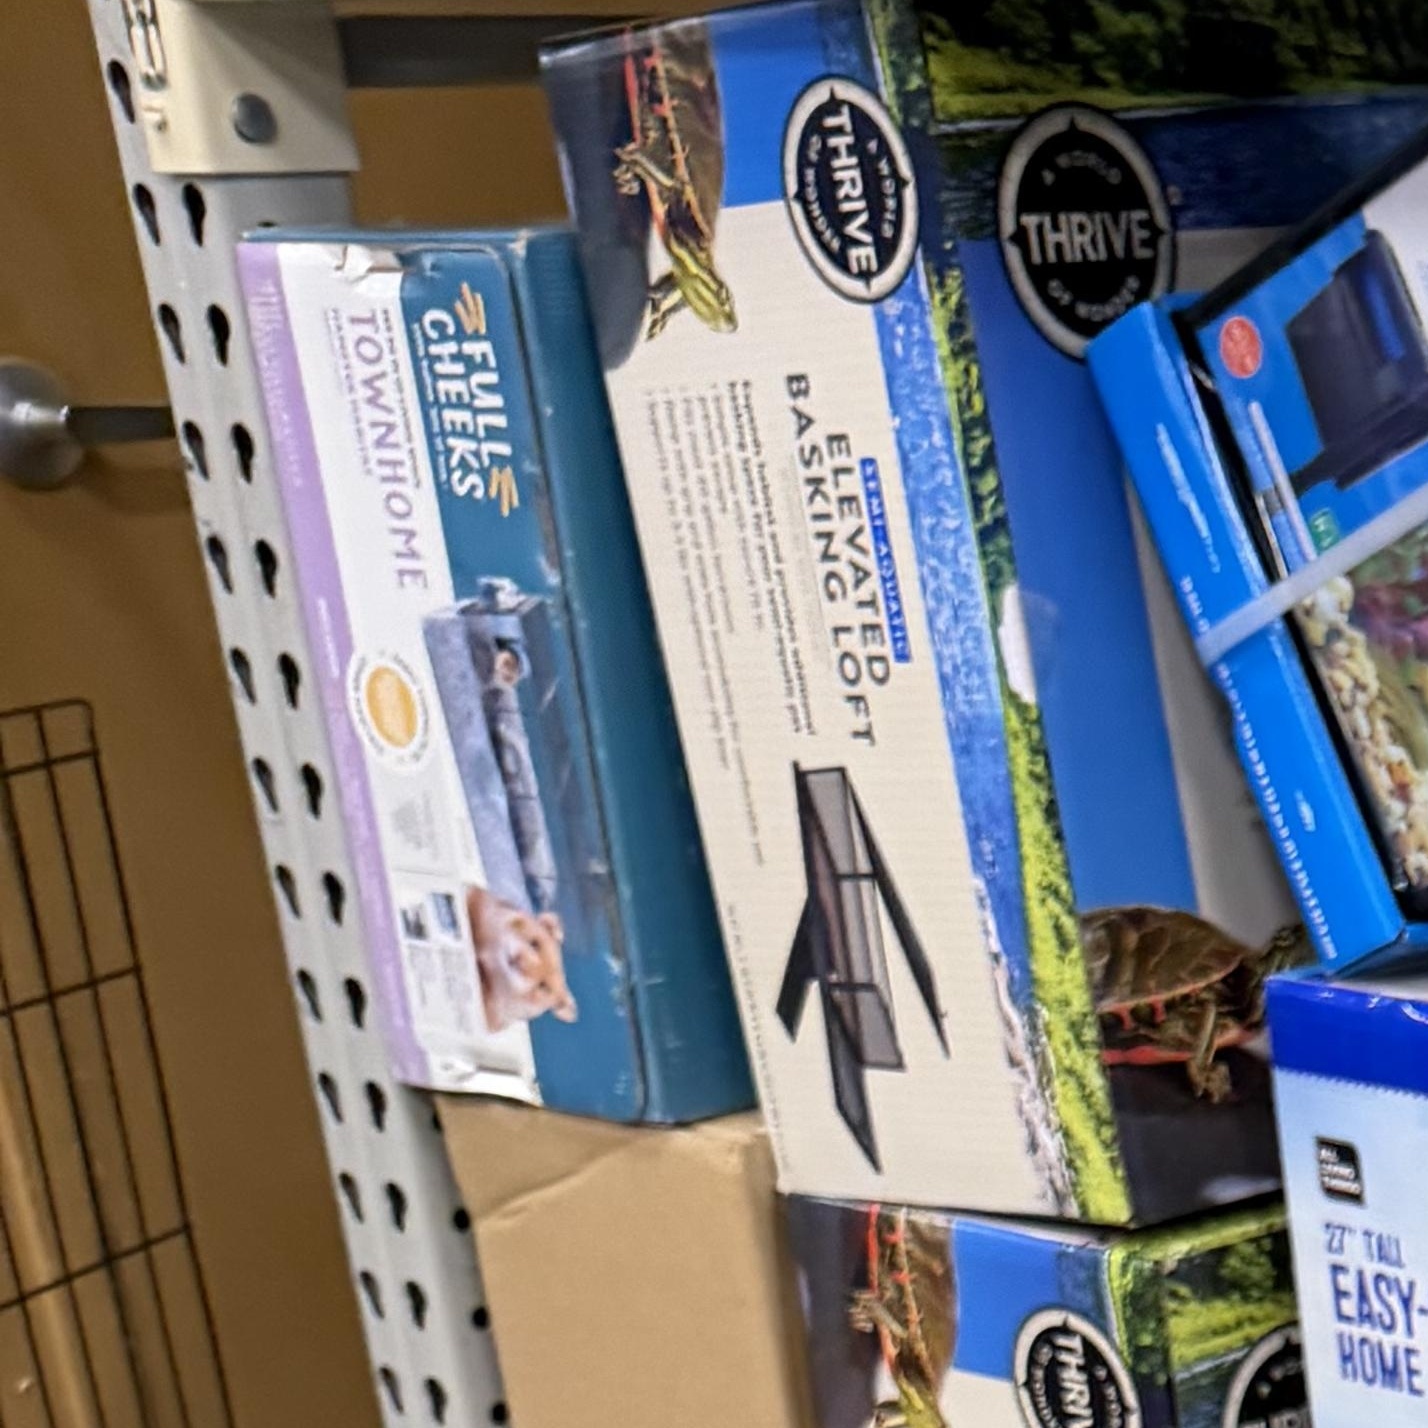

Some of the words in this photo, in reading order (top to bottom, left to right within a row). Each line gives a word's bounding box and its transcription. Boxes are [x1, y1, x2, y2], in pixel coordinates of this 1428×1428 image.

[821, 102, 879, 276] THRIVE
[1019, 209, 1156, 266] THRIVE
[347, 308, 429, 591] TOWNHOME
[419, 309, 486, 499] CHEEKS
[459, 335, 515, 469] FULL
[783, 371, 848, 604] BASKING
[829, 621, 877, 747] LOFT
[823, 431, 894, 688] ELEVATED
[1361, 1229, 1406, 1268] TALL
[1337, 1332, 1426, 1398] HOME
